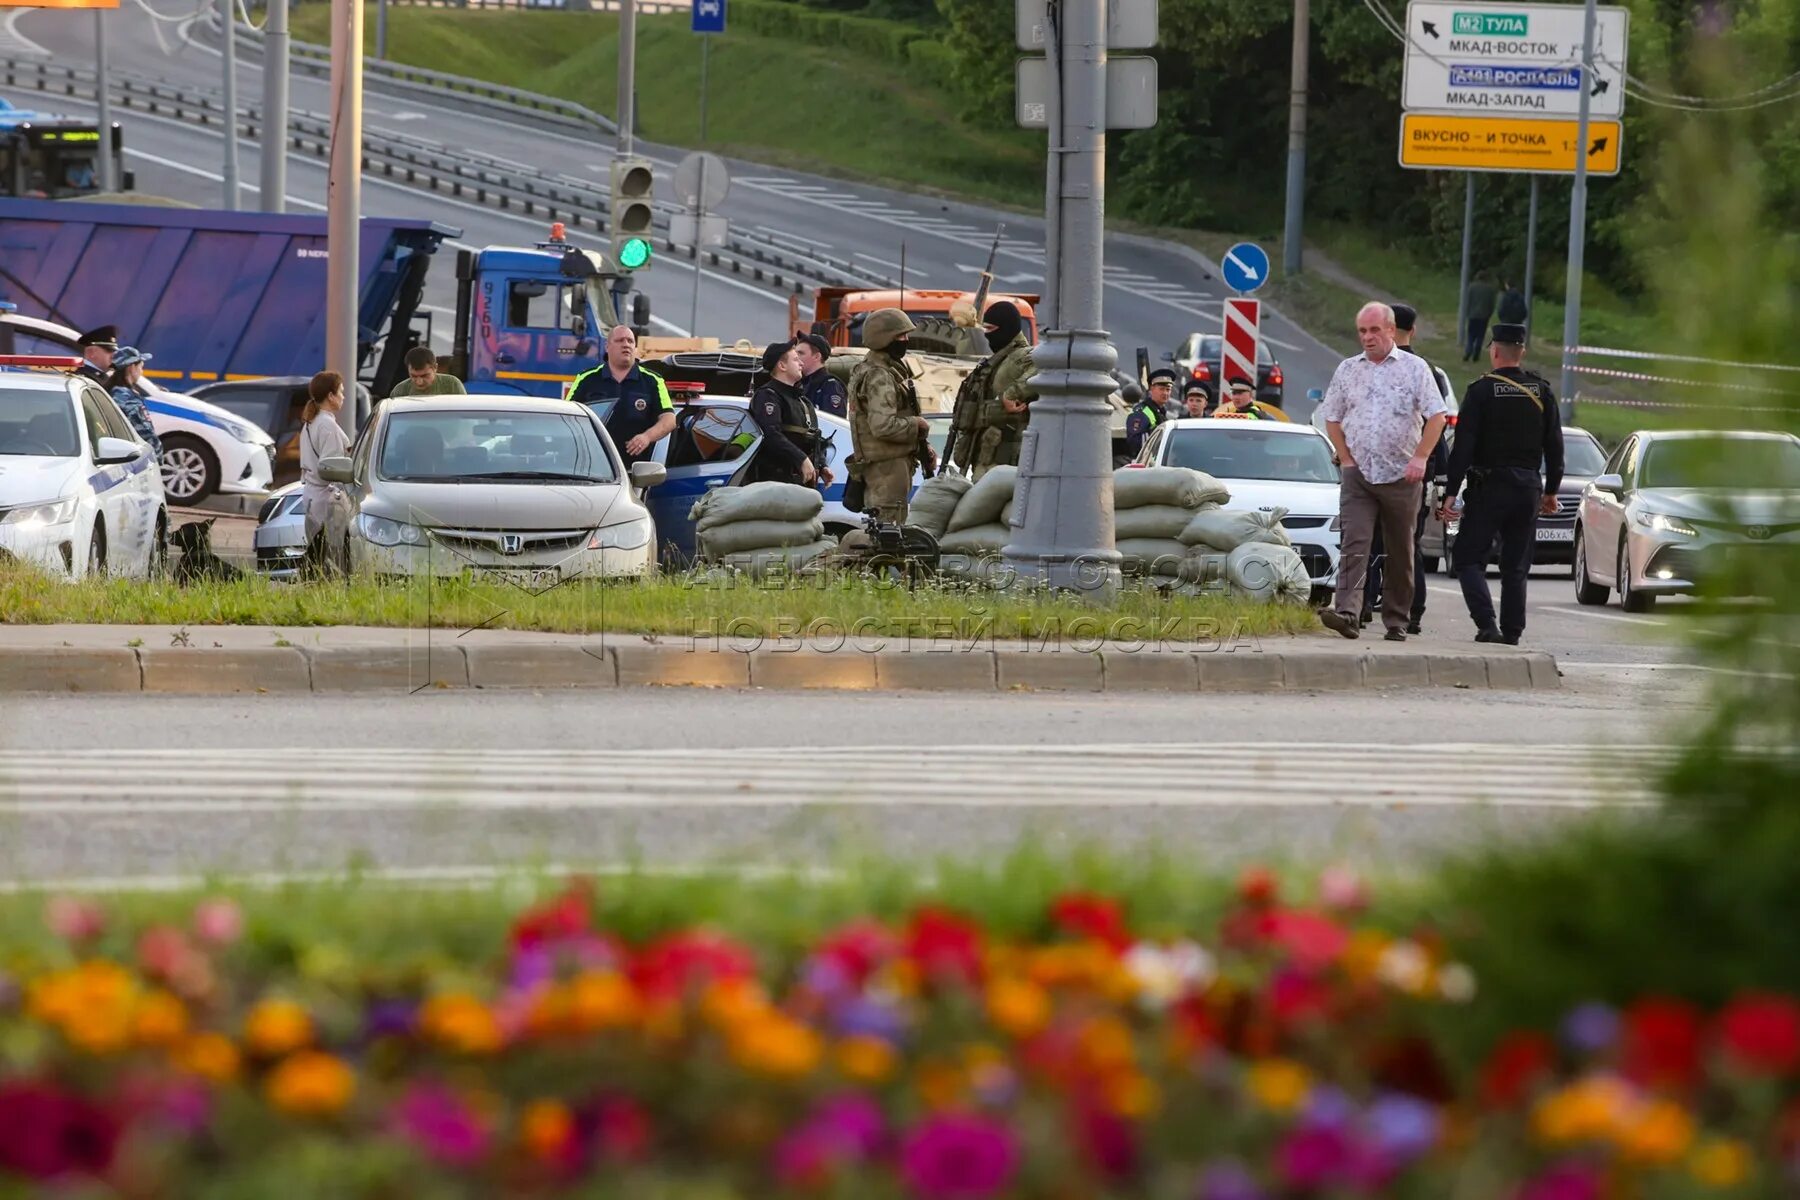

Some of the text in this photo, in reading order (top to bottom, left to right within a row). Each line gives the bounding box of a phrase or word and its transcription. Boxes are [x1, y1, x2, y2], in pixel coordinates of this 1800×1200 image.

[1459, 17, 1524, 32] М2 ТУЛА
[1449, 40, 1558, 55] МКАД-ВОСТОК
[1446, 92, 1546, 108] МКАД-ЗАПАД
[1413, 130, 1470, 143] ВКУСНО
[1487, 133, 1496, 143] И
[1501, 134, 1546, 145] ТОЧКА
